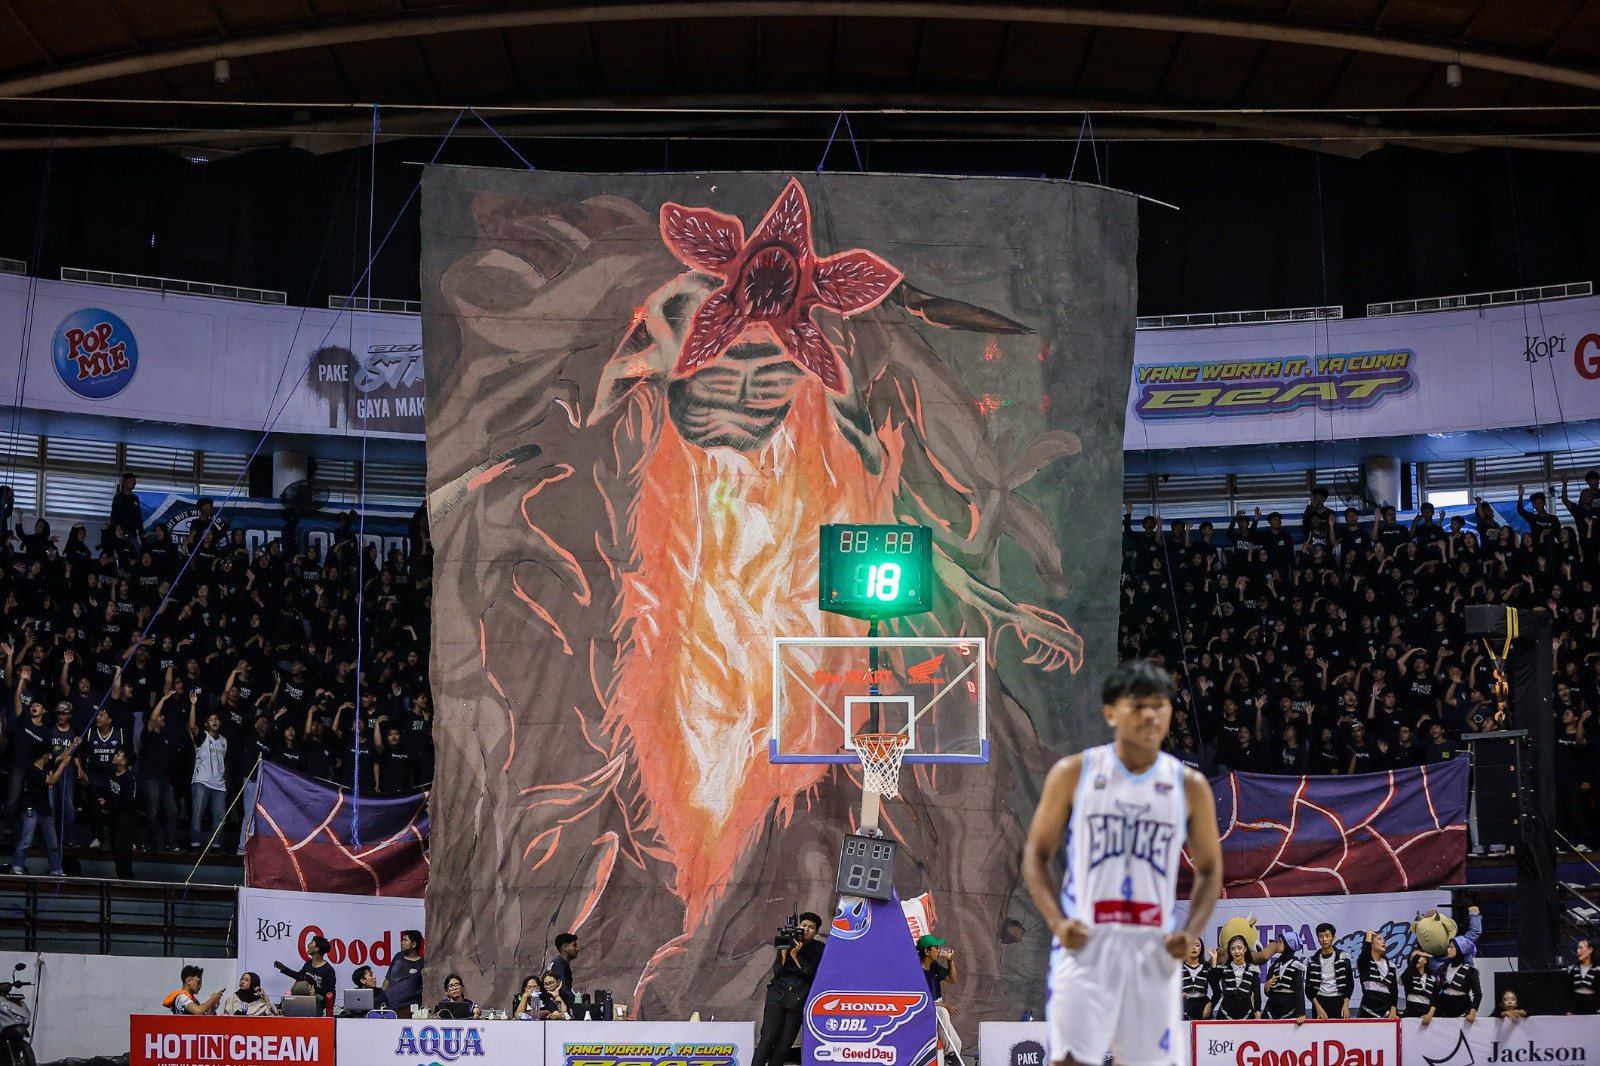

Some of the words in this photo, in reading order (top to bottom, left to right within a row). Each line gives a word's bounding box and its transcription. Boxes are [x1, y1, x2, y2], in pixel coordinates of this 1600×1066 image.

[65, 322, 113, 359] POP
[1522, 333, 1567, 363] Kopi
[77, 342, 130, 380] MIE
[318, 364, 349, 382] PAKE
[1138, 365, 1200, 383] YANG
[1203, 361, 1282, 381] WORTH
[1317, 357, 1346, 374] YA
[1347, 351, 1409, 372] CUMA
[357, 398, 390, 419] GAYA
[1120, 875, 1134, 901] 4
[255, 917, 293, 942] Kopi
[840, 1003, 898, 1012] HONDA
[838, 1018, 868, 1032] DBL
[145, 1033, 197, 1060] HOT
[229, 1035, 319, 1062] CREAM
[395, 1025, 484, 1062] AQUA
[565, 1044, 602, 1055] YANG
[604, 1044, 655, 1055] WORTH
[676, 1045, 694, 1056] YA
[695, 1045, 733, 1056] CUMA
[1157, 1027, 1171, 1053] 4
[1208, 1039, 1235, 1055] Kopi
[1487, 1040, 1587, 1063] Jackson
[842, 1047, 871, 1059] Good
[871, 1047, 894, 1061] Day
[1017, 1051, 1040, 1066] PAKE
